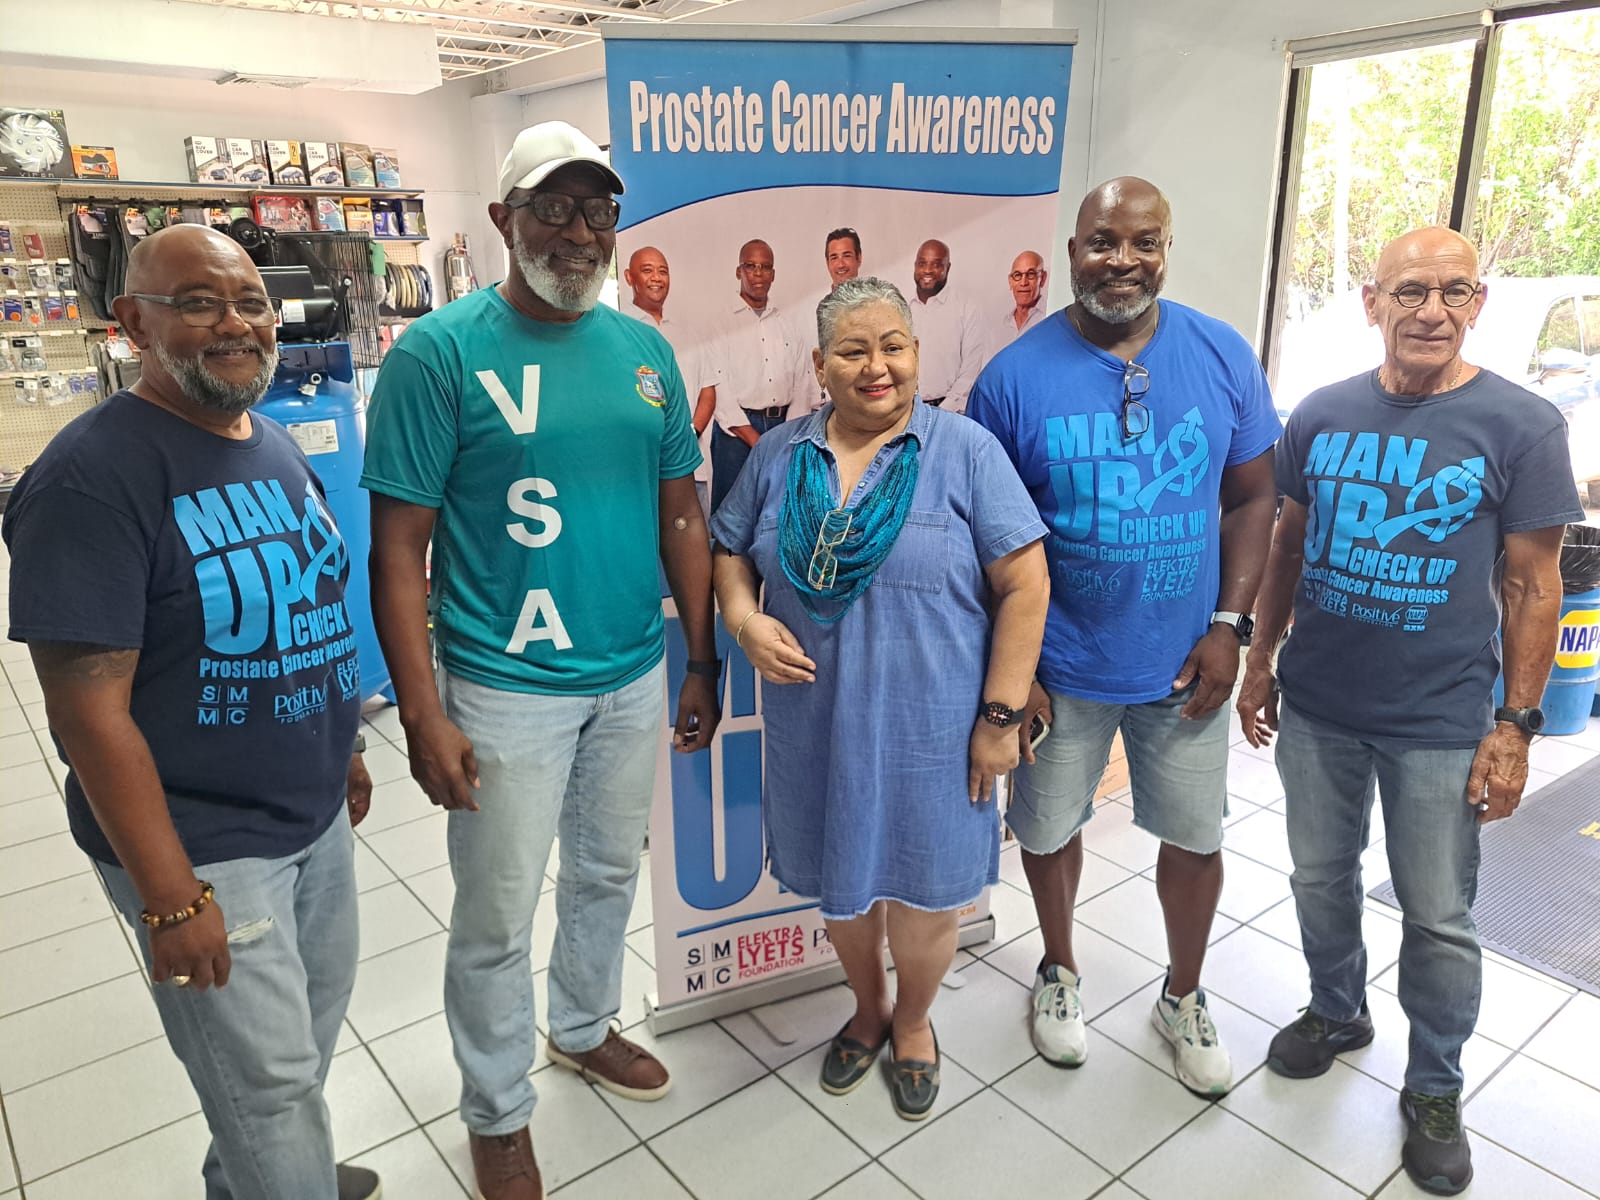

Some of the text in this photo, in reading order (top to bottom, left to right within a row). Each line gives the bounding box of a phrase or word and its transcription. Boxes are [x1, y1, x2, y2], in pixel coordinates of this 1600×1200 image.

[629, 79, 1056, 155] Prostate Cancer Awareness
[1046, 411, 1156, 460] MAN
[1303, 432, 1429, 487] MAN
[173, 480, 302, 556] MAN
[1050, 460, 1141, 544] UP
[1122, 510, 1207, 545] CHECK UP
[1304, 479, 1388, 569] UP
[1101, 545, 1146, 562] Cancer
[1148, 539, 1207, 560] Awareness
[1147, 554, 1199, 574] ELEKTRA
[1350, 546, 1426, 584] CHECK
[1426, 558, 1457, 585] UP
[195, 540, 303, 655] UP
[1142, 567, 1198, 593] LYETS
[1328, 570, 1370, 595] Cancer
[1371, 581, 1449, 604] Awareness
[199, 657, 279, 678] Prostate
[274, 671, 329, 715] Positiv
[737, 925, 804, 949] ELEKTRA
[738, 937, 805, 969] LYETS
[738, 956, 805, 979] FOUNDATION
